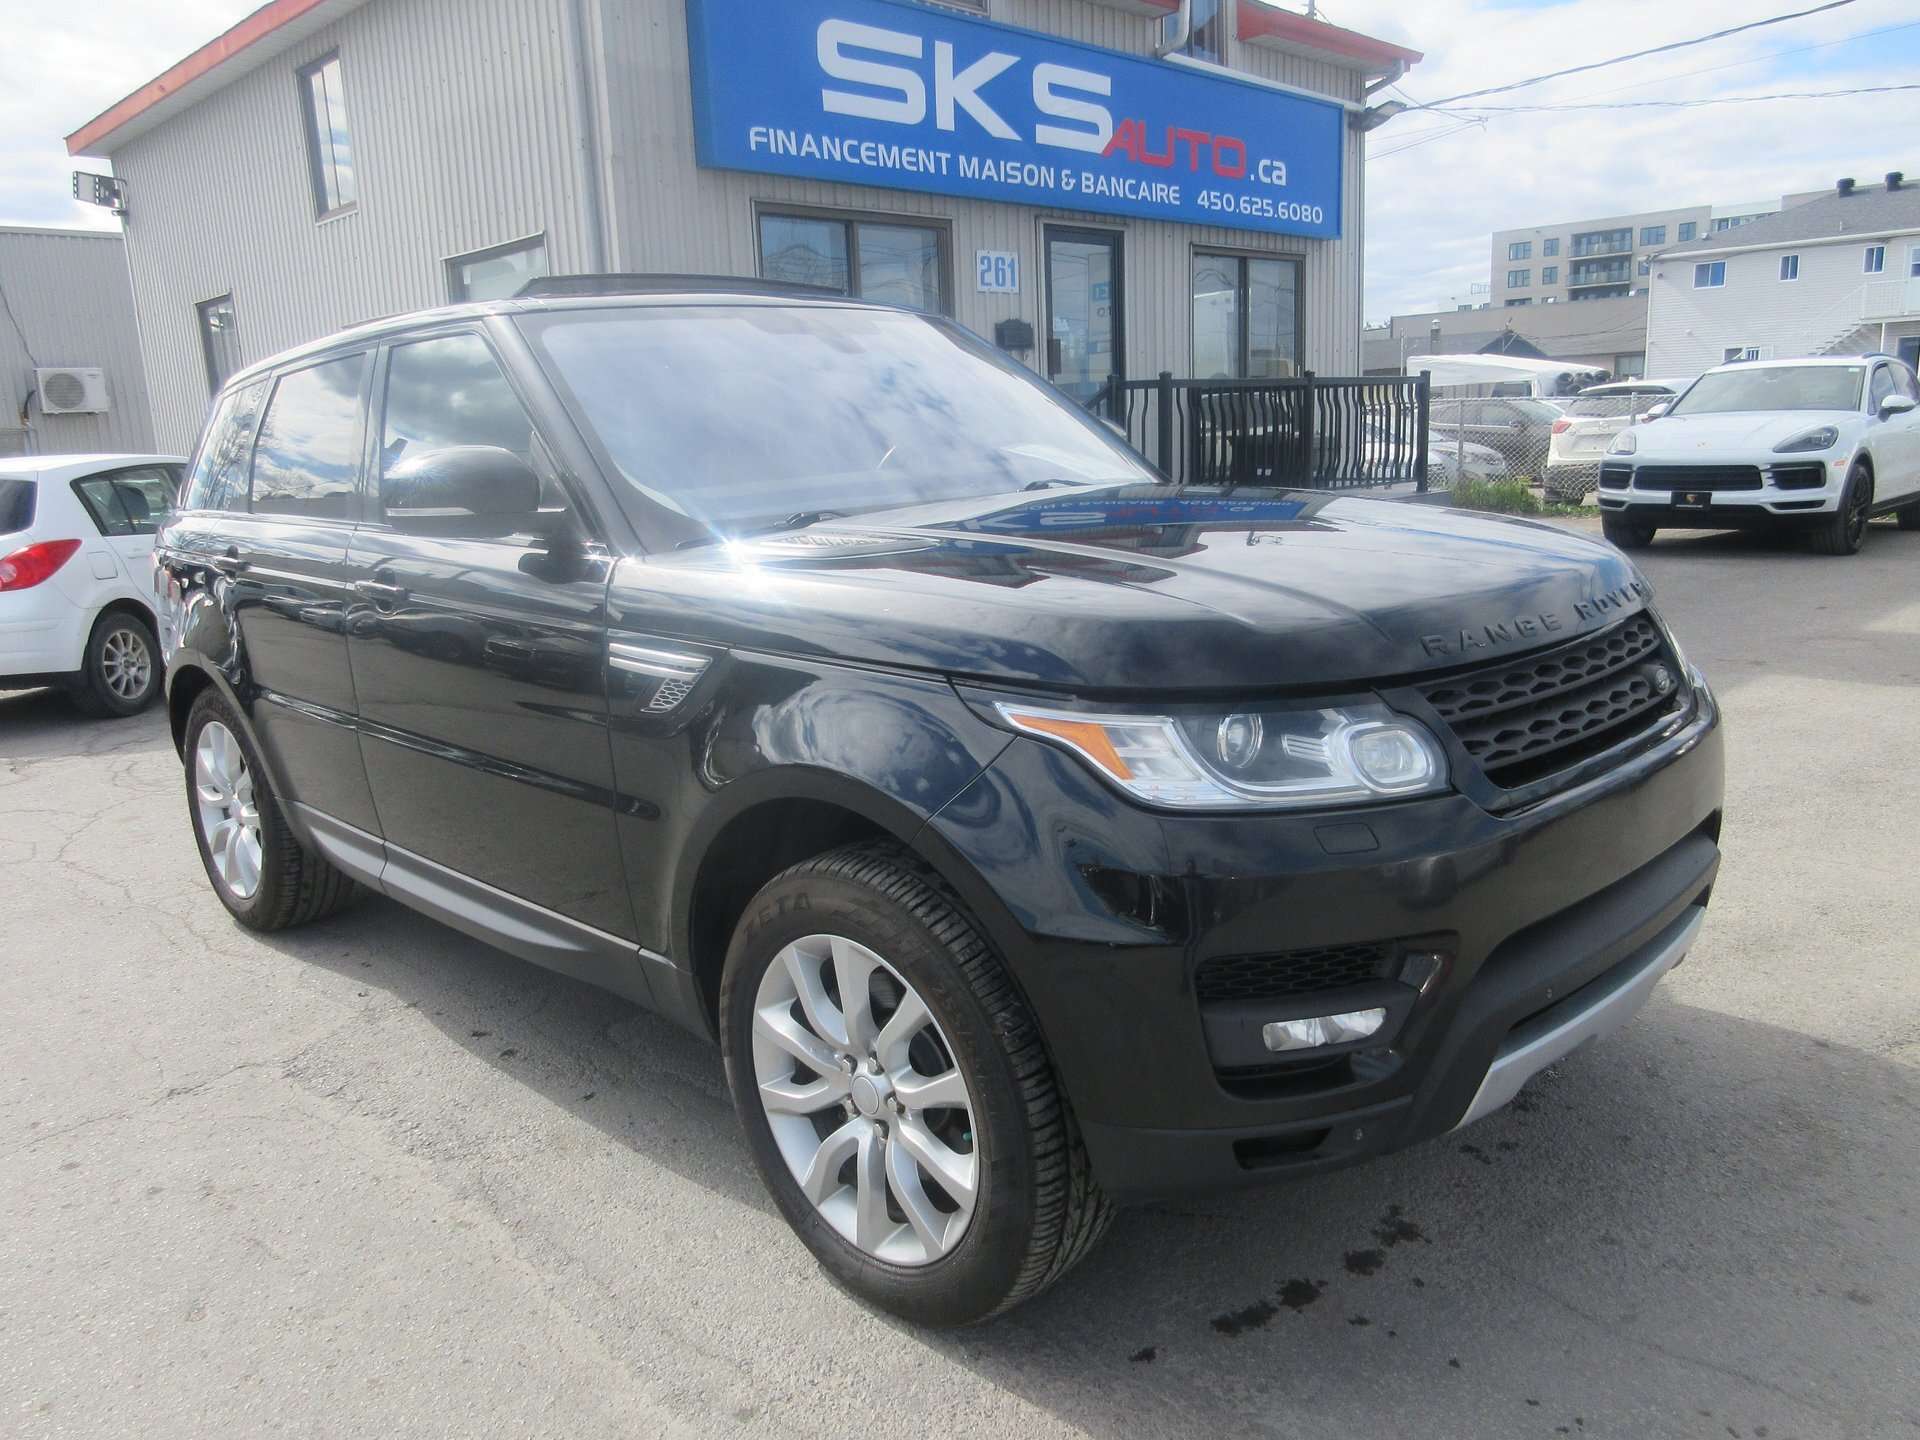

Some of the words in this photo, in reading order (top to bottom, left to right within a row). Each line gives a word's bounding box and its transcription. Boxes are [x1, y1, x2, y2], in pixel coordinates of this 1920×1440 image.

[816, 18, 1113, 155] SKS
[749, 126, 951, 176] FINANCEMENT
[958, 154, 1055, 189] MAISON
[1060, 168, 1076, 191] &
[1080, 172, 1181, 206] BANCAIRE
[1196, 189, 1323, 225] 450.625.6080
[979, 254, 1016, 289] 261
[1418, 612, 1563, 658] RANGE
